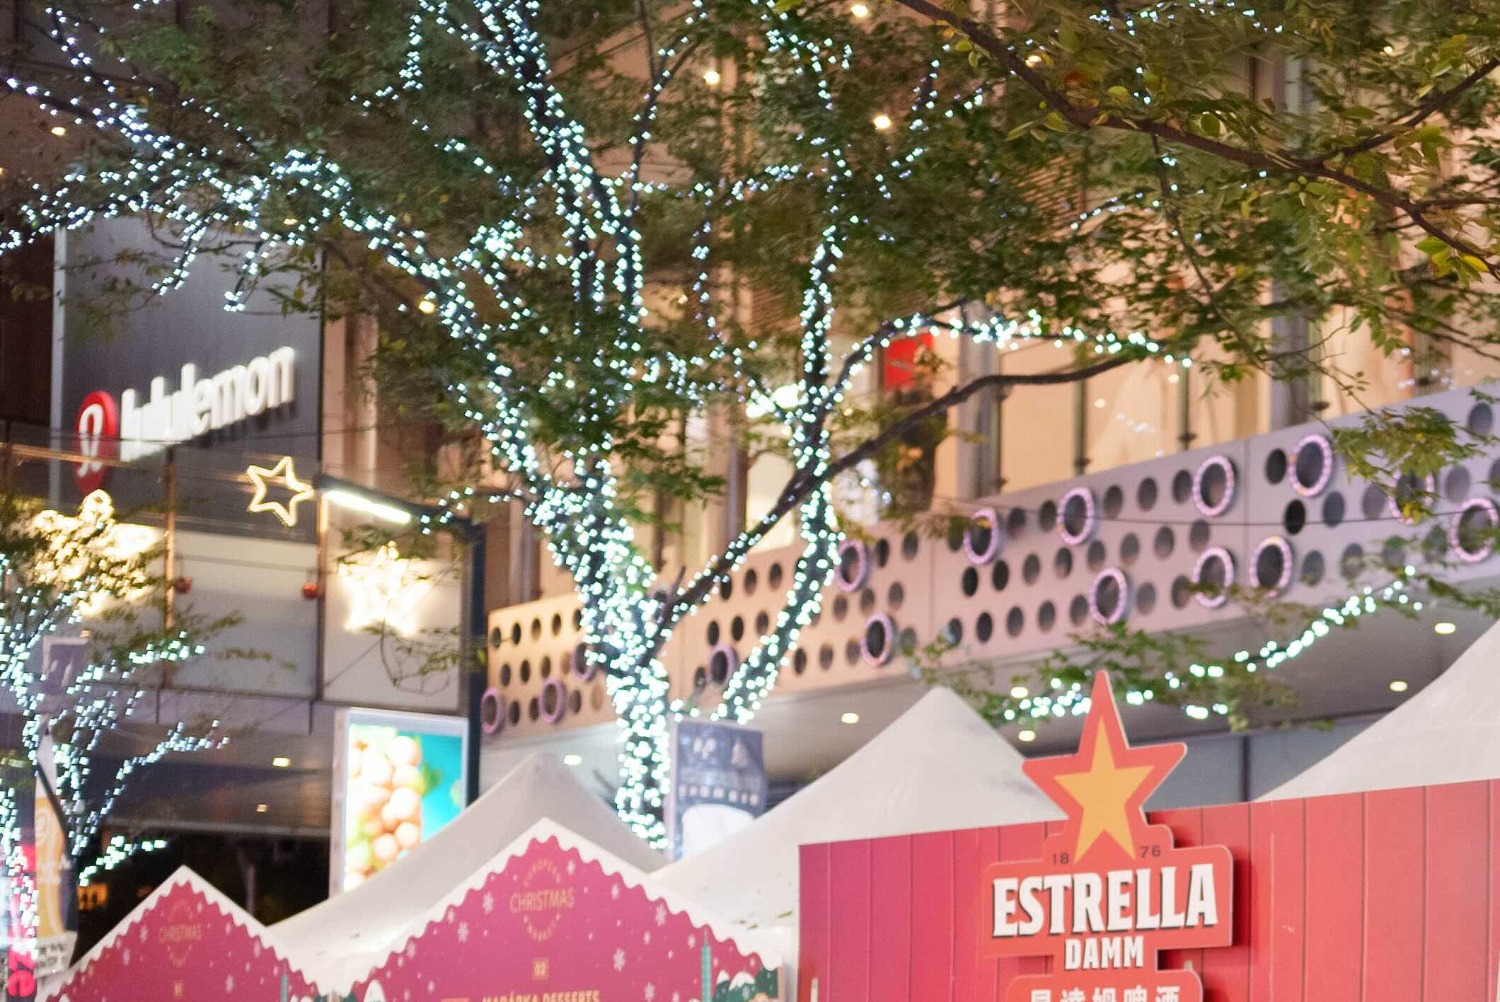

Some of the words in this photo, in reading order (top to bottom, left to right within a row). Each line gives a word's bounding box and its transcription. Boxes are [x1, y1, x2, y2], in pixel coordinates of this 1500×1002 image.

[121, 346, 295, 462] lululemon
[1052, 852, 1070, 865] 18
[1139, 845, 1161, 858] 76
[510, 887, 575, 913] CHRISTMAS
[992, 863, 1219, 937] ESTRELLA
[1064, 935, 1144, 971] DAMM
